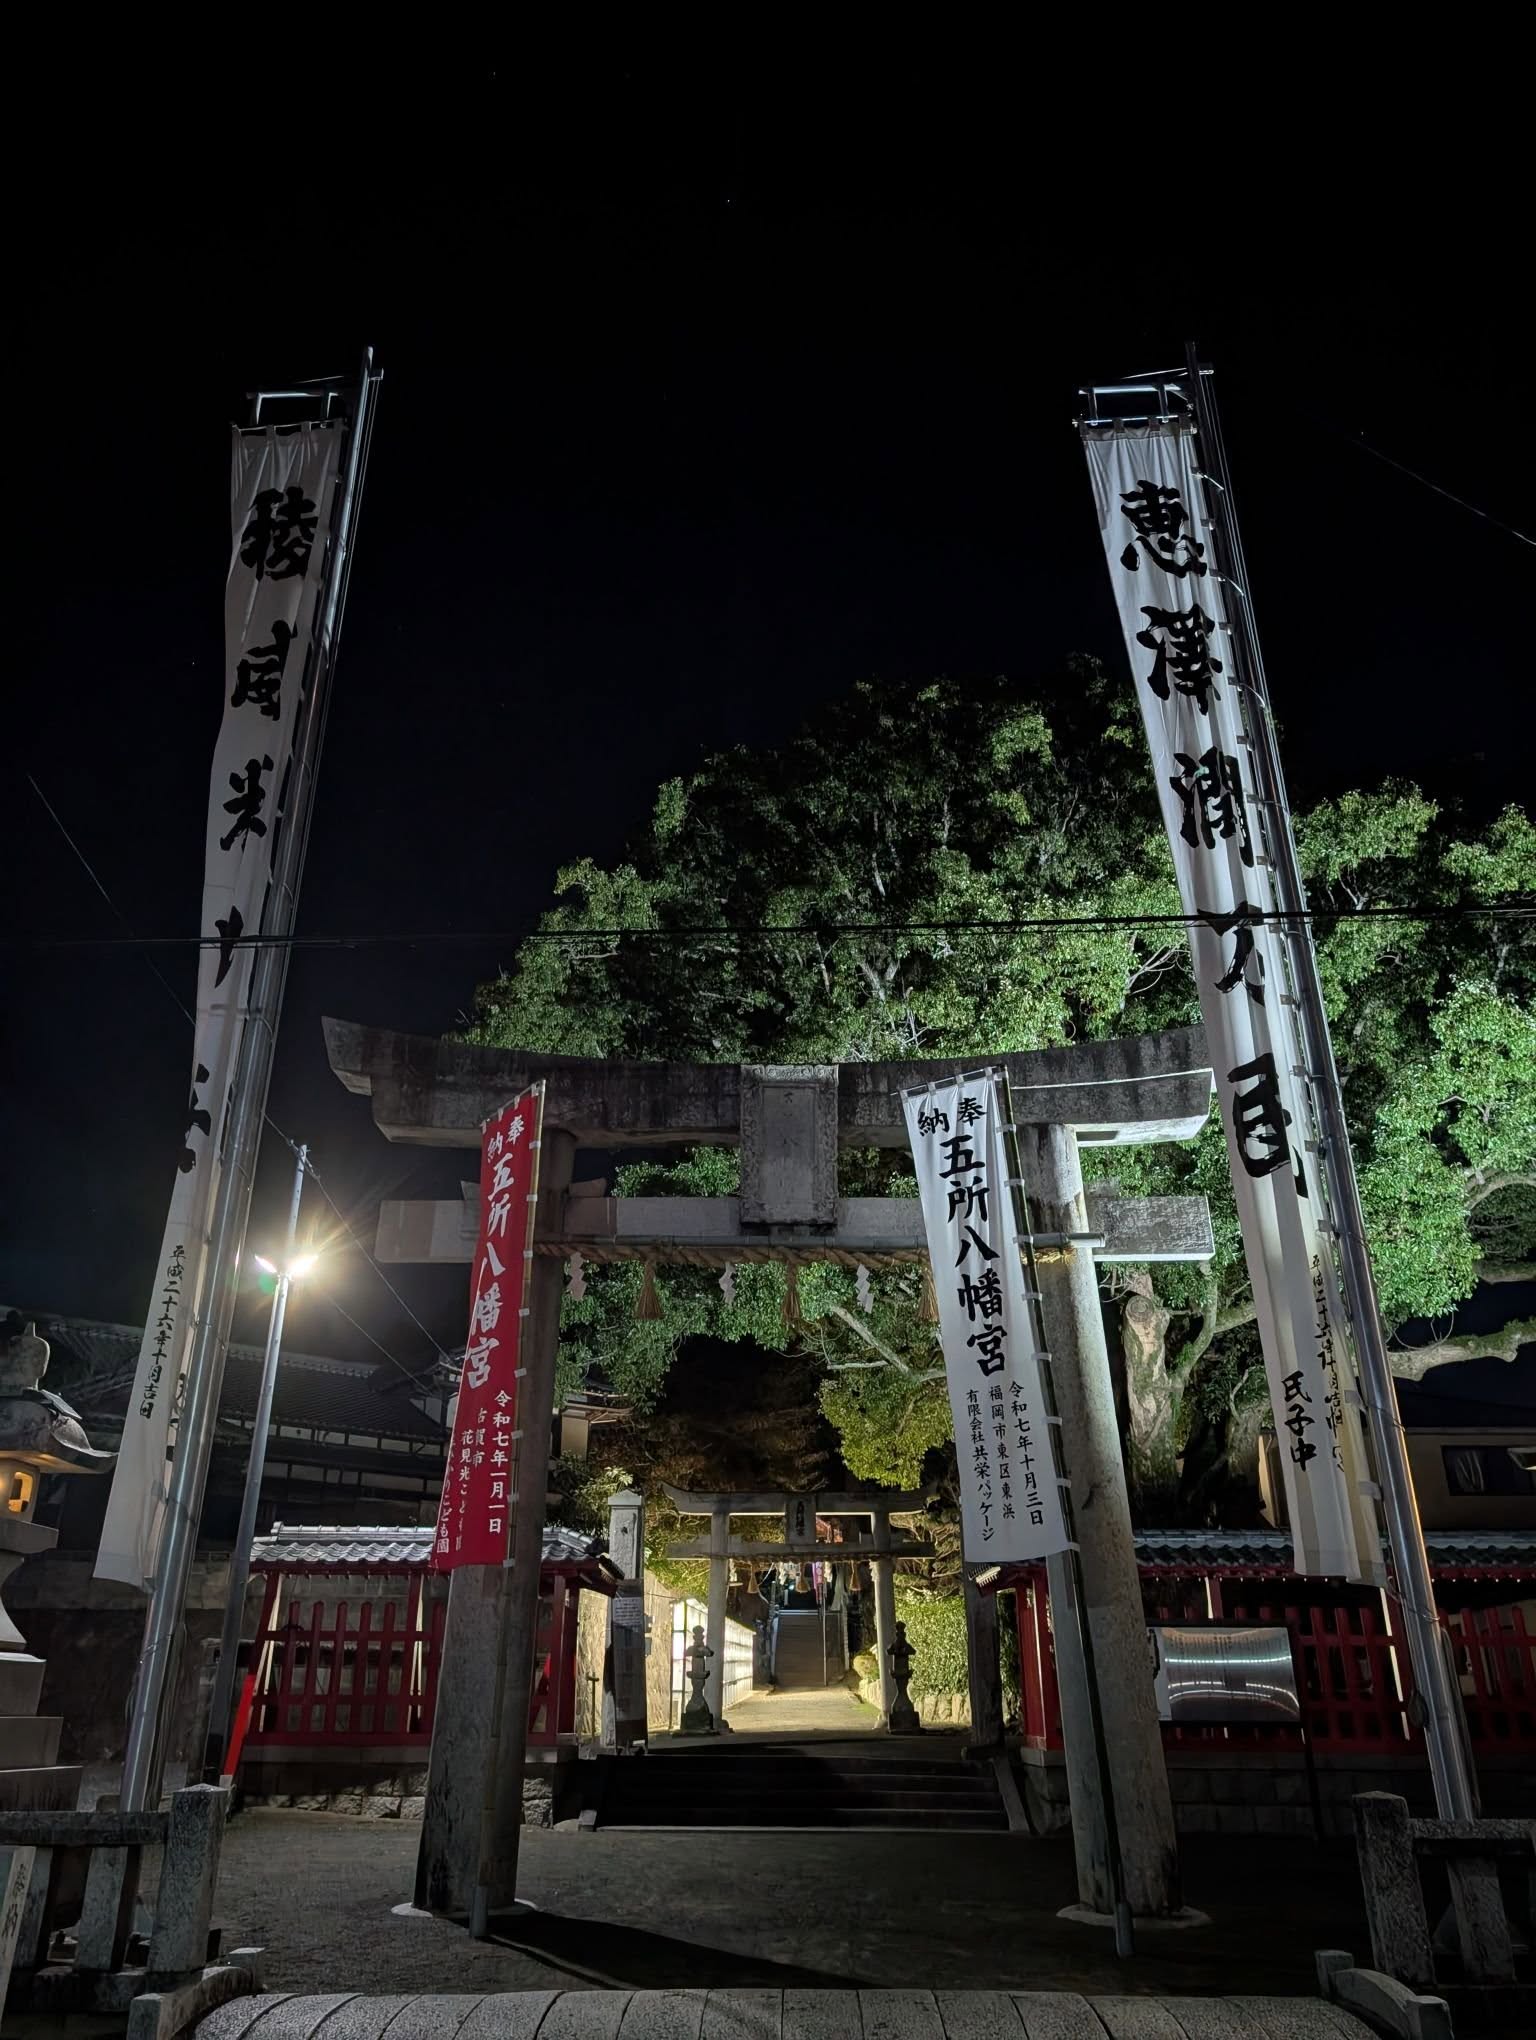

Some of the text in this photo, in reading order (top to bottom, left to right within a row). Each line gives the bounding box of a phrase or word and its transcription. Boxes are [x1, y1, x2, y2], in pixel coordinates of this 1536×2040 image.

[487, 1113, 525, 1163] 奉納
[918, 1097, 987, 1137] 奉納
[465, 1153, 515, 1390] 五所八幡宮
[940, 1134, 1008, 1377] 五所八幡宮
[472, 1407, 489, 1468] 古賀市
[488, 1389, 513, 1535] 令和七年一月一日
[966, 1389, 996, 1542] 有限会社共栄パッケージ
[988, 1384, 1016, 1520] 福岡市東区東浜
[1009, 1381, 1045, 1526] 令和七年十月三日
